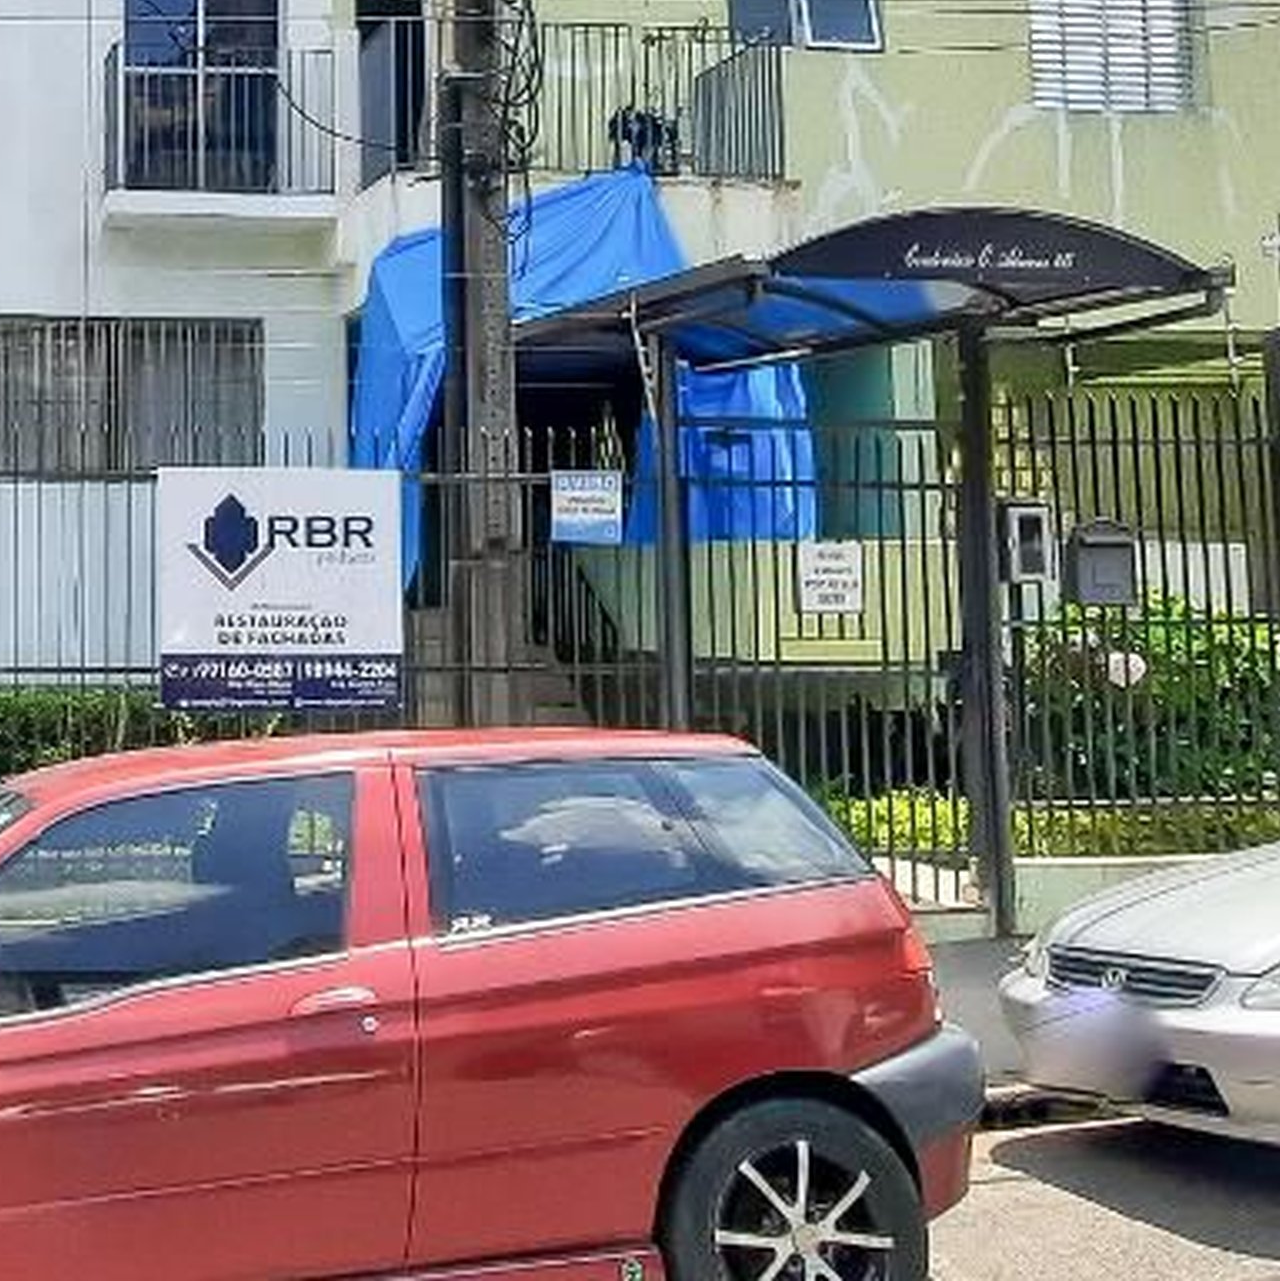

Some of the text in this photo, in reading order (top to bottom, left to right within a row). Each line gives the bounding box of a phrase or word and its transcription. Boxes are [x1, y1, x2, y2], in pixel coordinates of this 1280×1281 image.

[267, 515, 375, 548] RBR
[217, 631, 348, 646] DE FACHADAS
